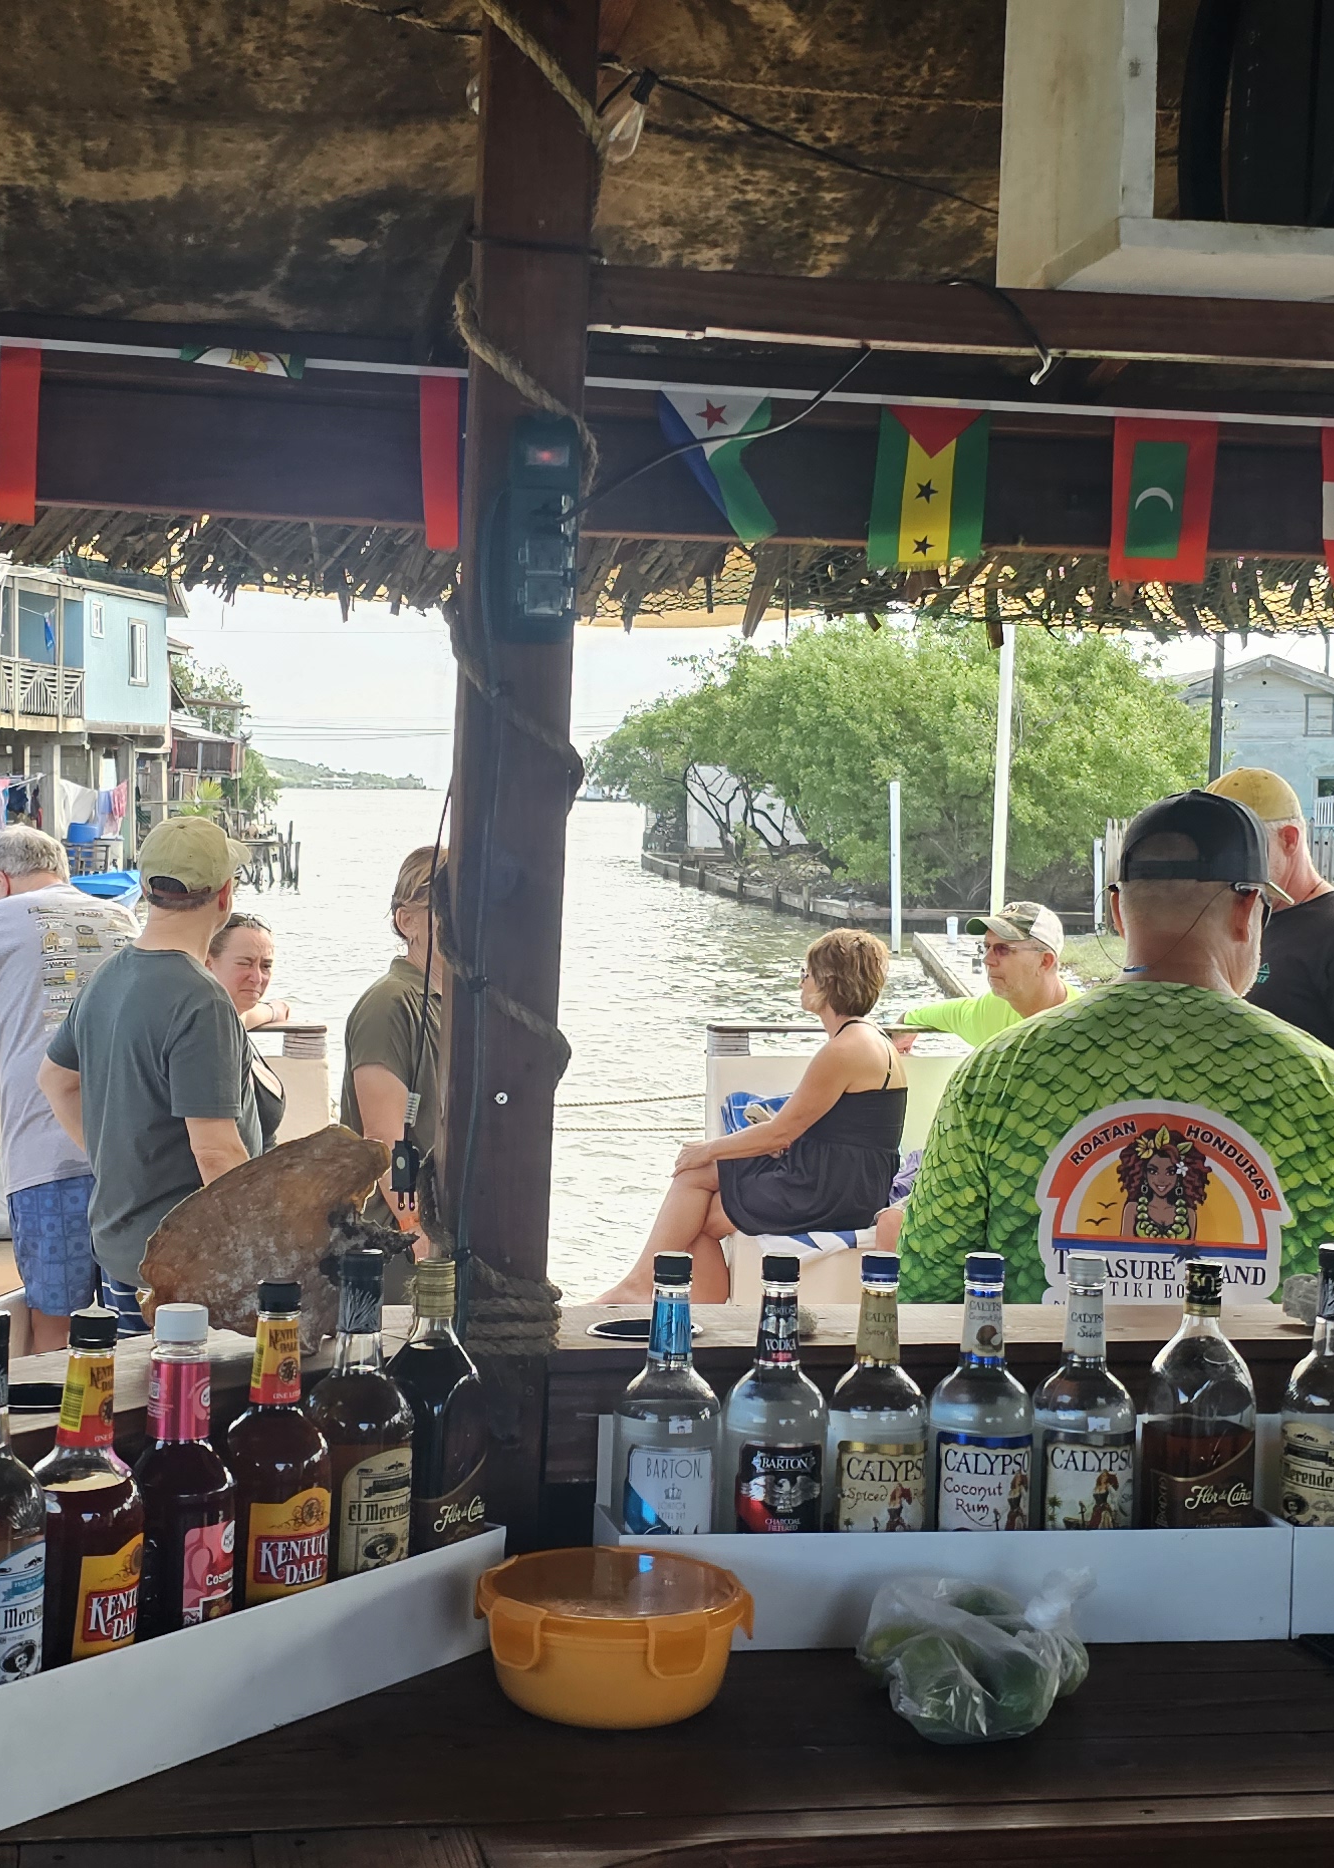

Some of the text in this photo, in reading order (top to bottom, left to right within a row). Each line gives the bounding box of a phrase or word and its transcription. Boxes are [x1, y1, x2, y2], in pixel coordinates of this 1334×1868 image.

[1069, 1120, 1137, 1166] ROATAN
[1185, 1124, 1272, 1201] HONDURAS
[1053, 1248, 1176, 1281] TASURE
[1111, 1281, 1154, 1299] TIKI
[765, 1339, 797, 1350] VODKA
[762, 1457, 809, 1470] BARTON
[845, 1485, 889, 1510] Spiced
[943, 1477, 1003, 1502] Coconut
[1185, 1485, 1218, 1510] Flor
[1227, 1483, 1252, 1507] Caña
[348, 1503, 362, 1522] El
[434, 1502, 462, 1533] Flor
[955, 1498, 990, 1521] Rum
[284, 1557, 324, 1586] DALE
